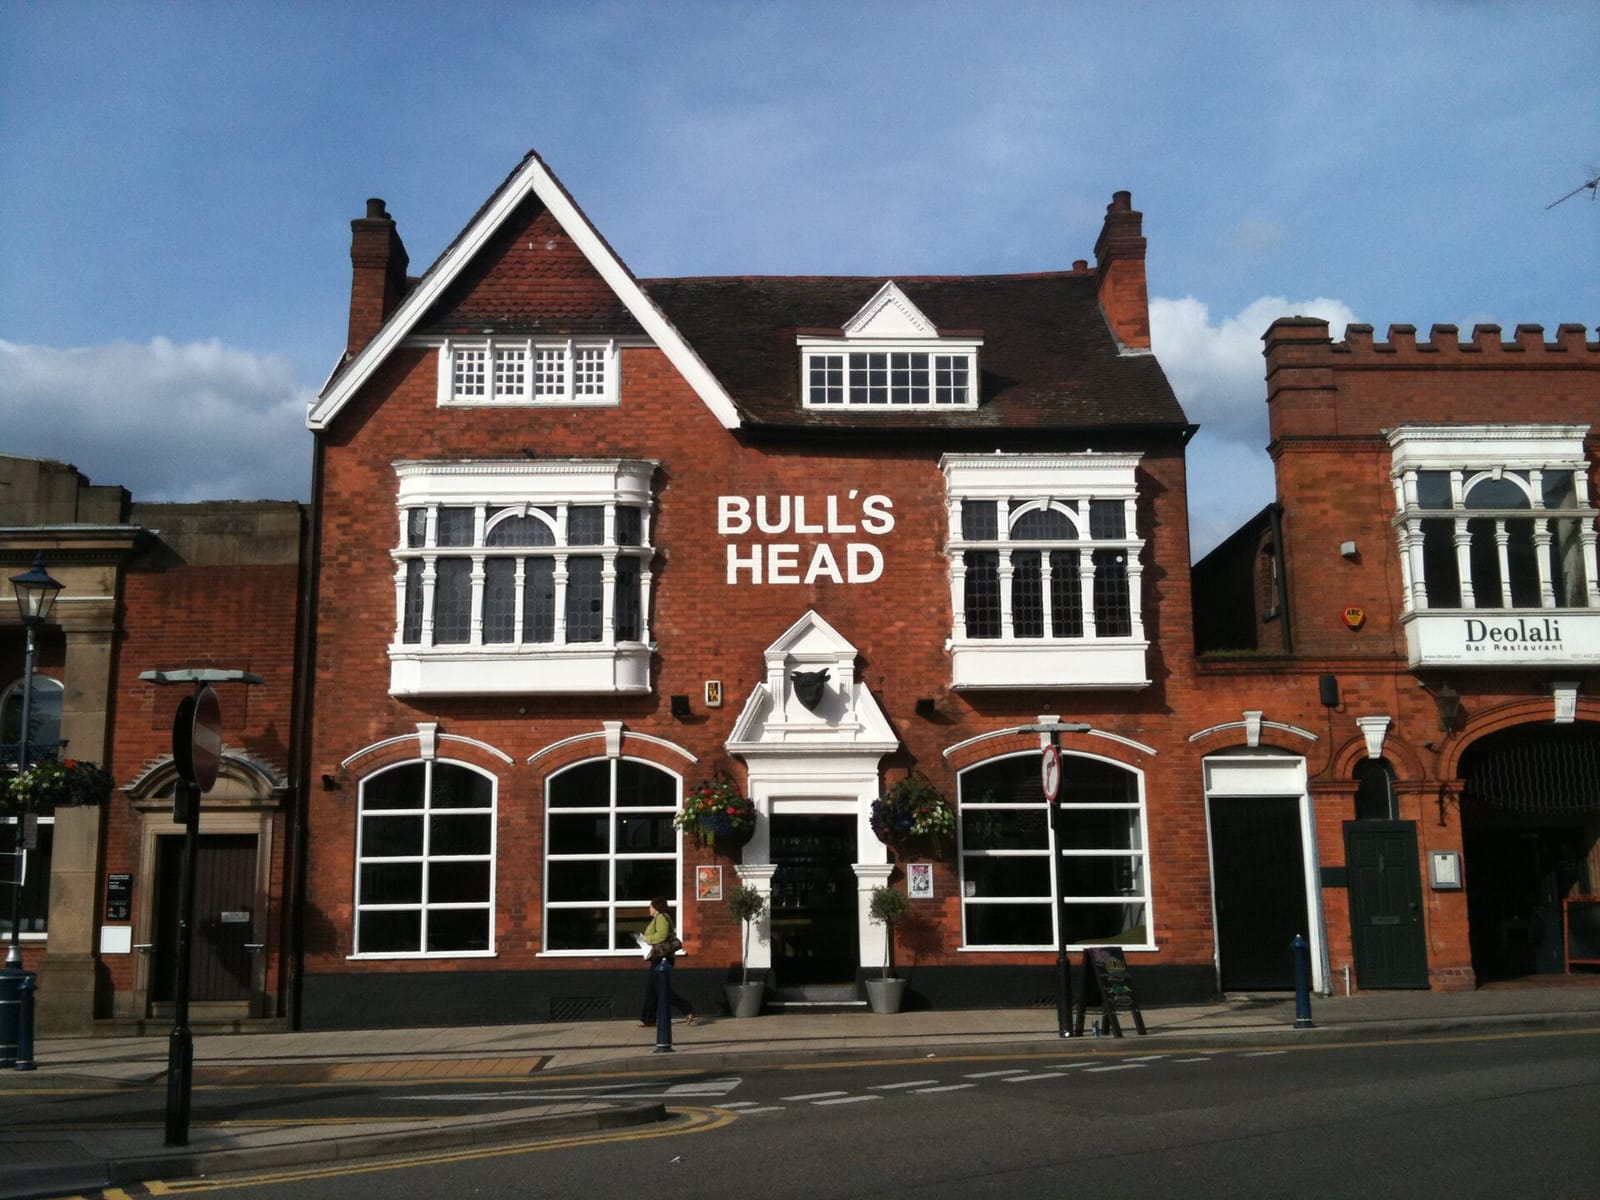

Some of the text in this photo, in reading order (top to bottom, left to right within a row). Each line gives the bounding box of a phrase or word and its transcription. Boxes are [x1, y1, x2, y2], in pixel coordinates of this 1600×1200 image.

[718, 490, 895, 534] BULL'S
[727, 543, 884, 584] HEAD
[1464, 618, 1562, 642] Deolali
[1465, 643, 1564, 652] Bar Restaurant
